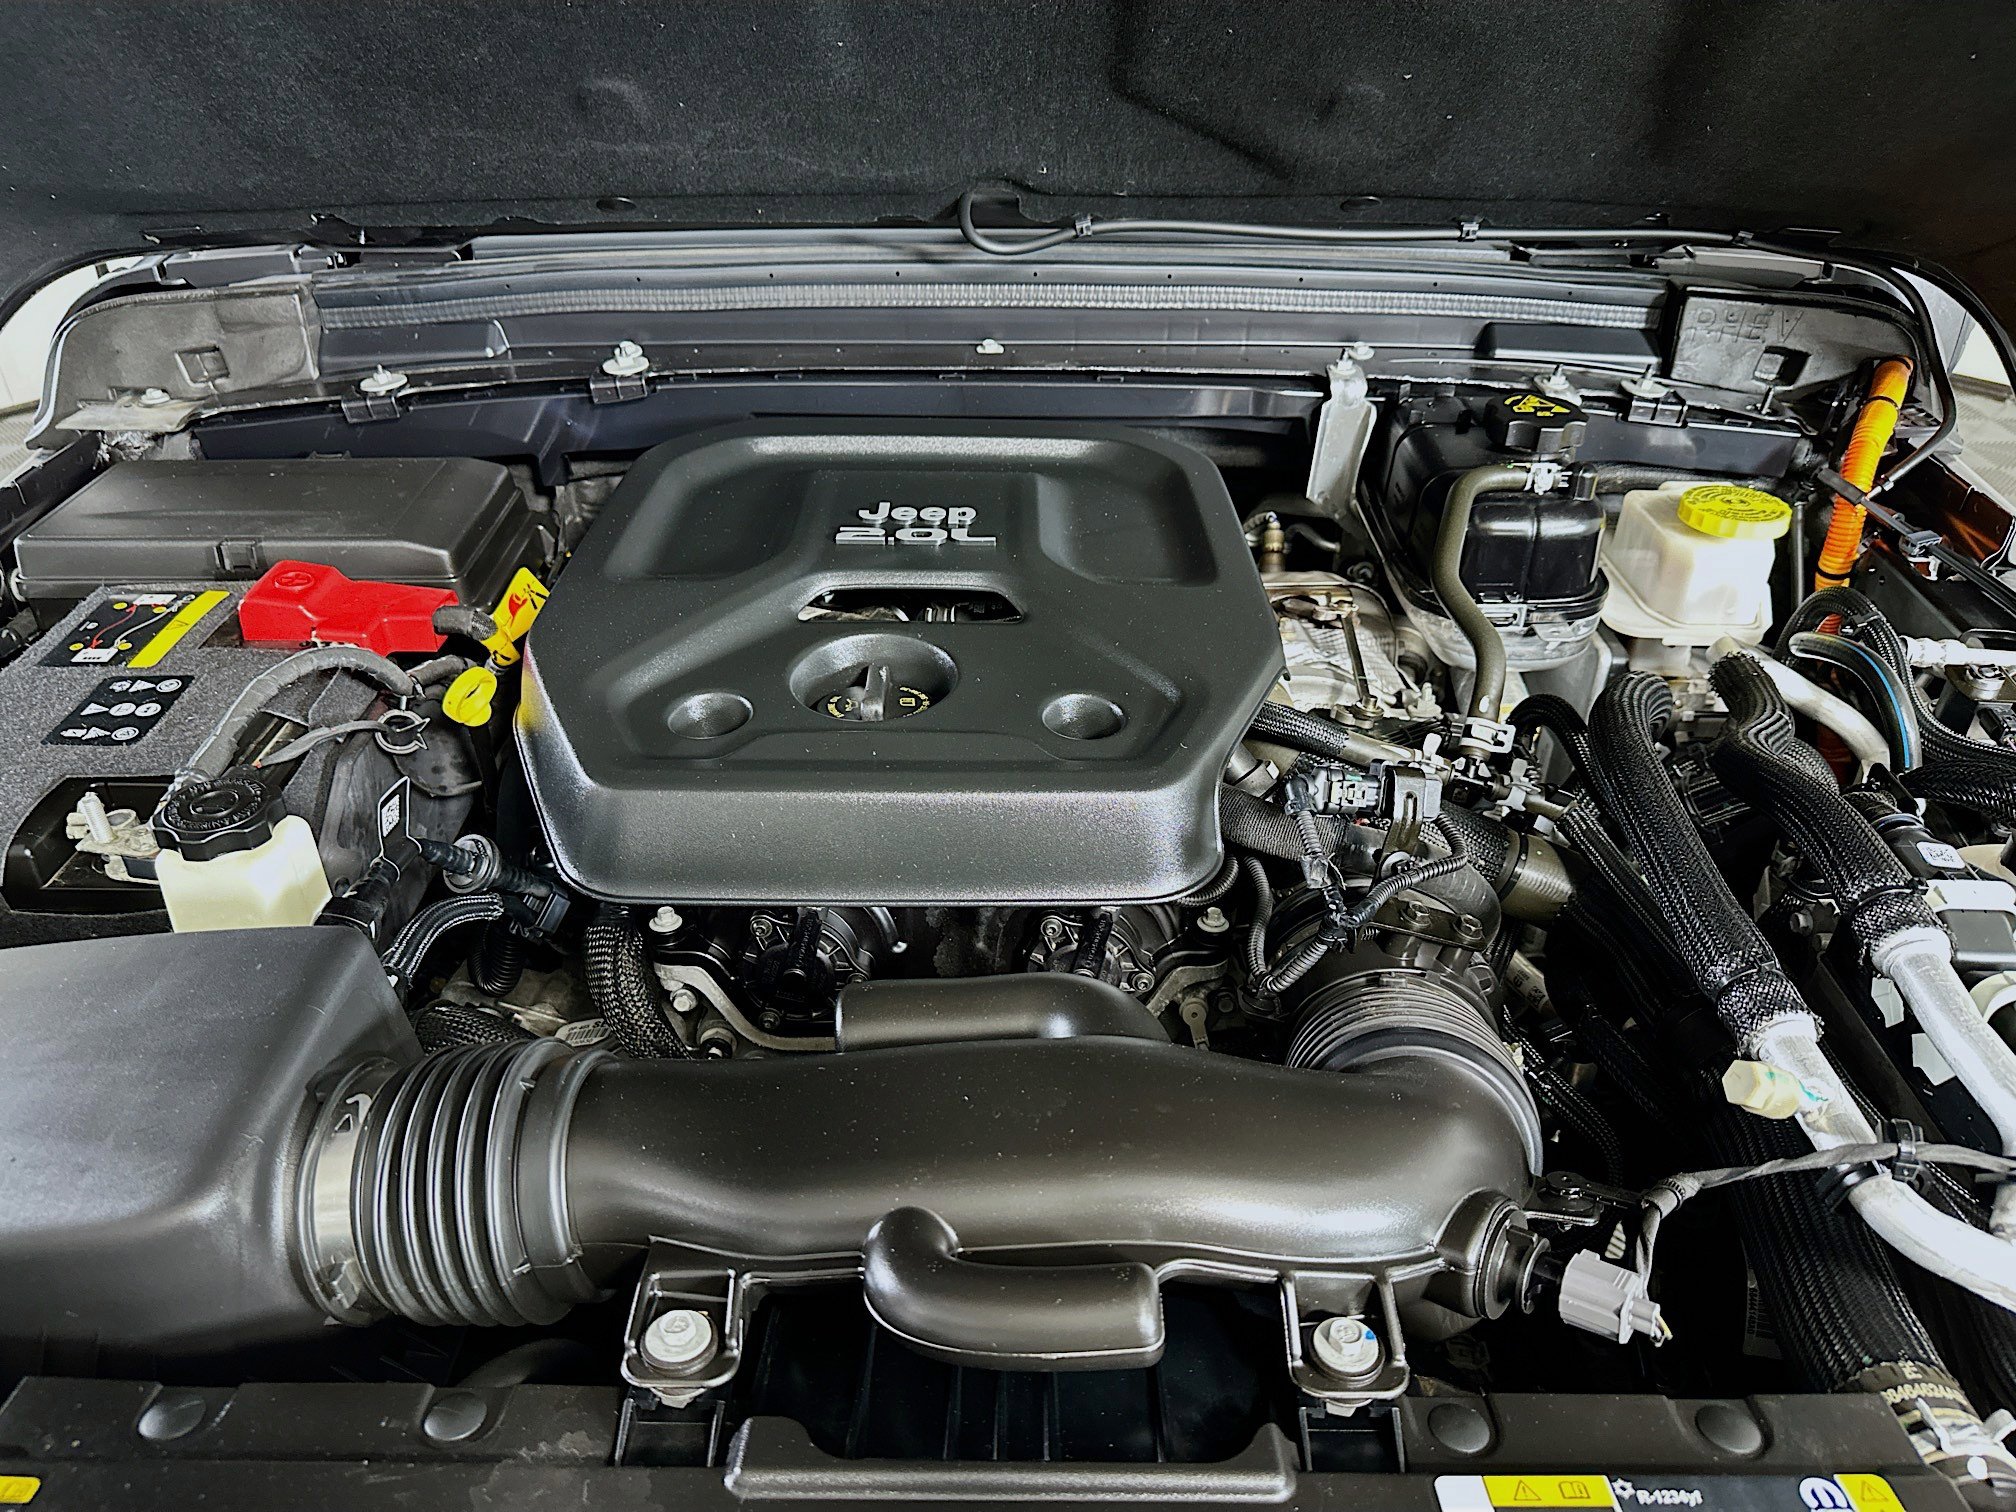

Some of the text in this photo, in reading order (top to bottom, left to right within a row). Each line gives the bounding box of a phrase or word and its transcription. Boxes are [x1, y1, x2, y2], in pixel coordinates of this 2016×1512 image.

[1688, 307, 1804, 344] PHEV
[858, 502, 977, 527] Jeep
[835, 526, 997, 546] 2.0L
